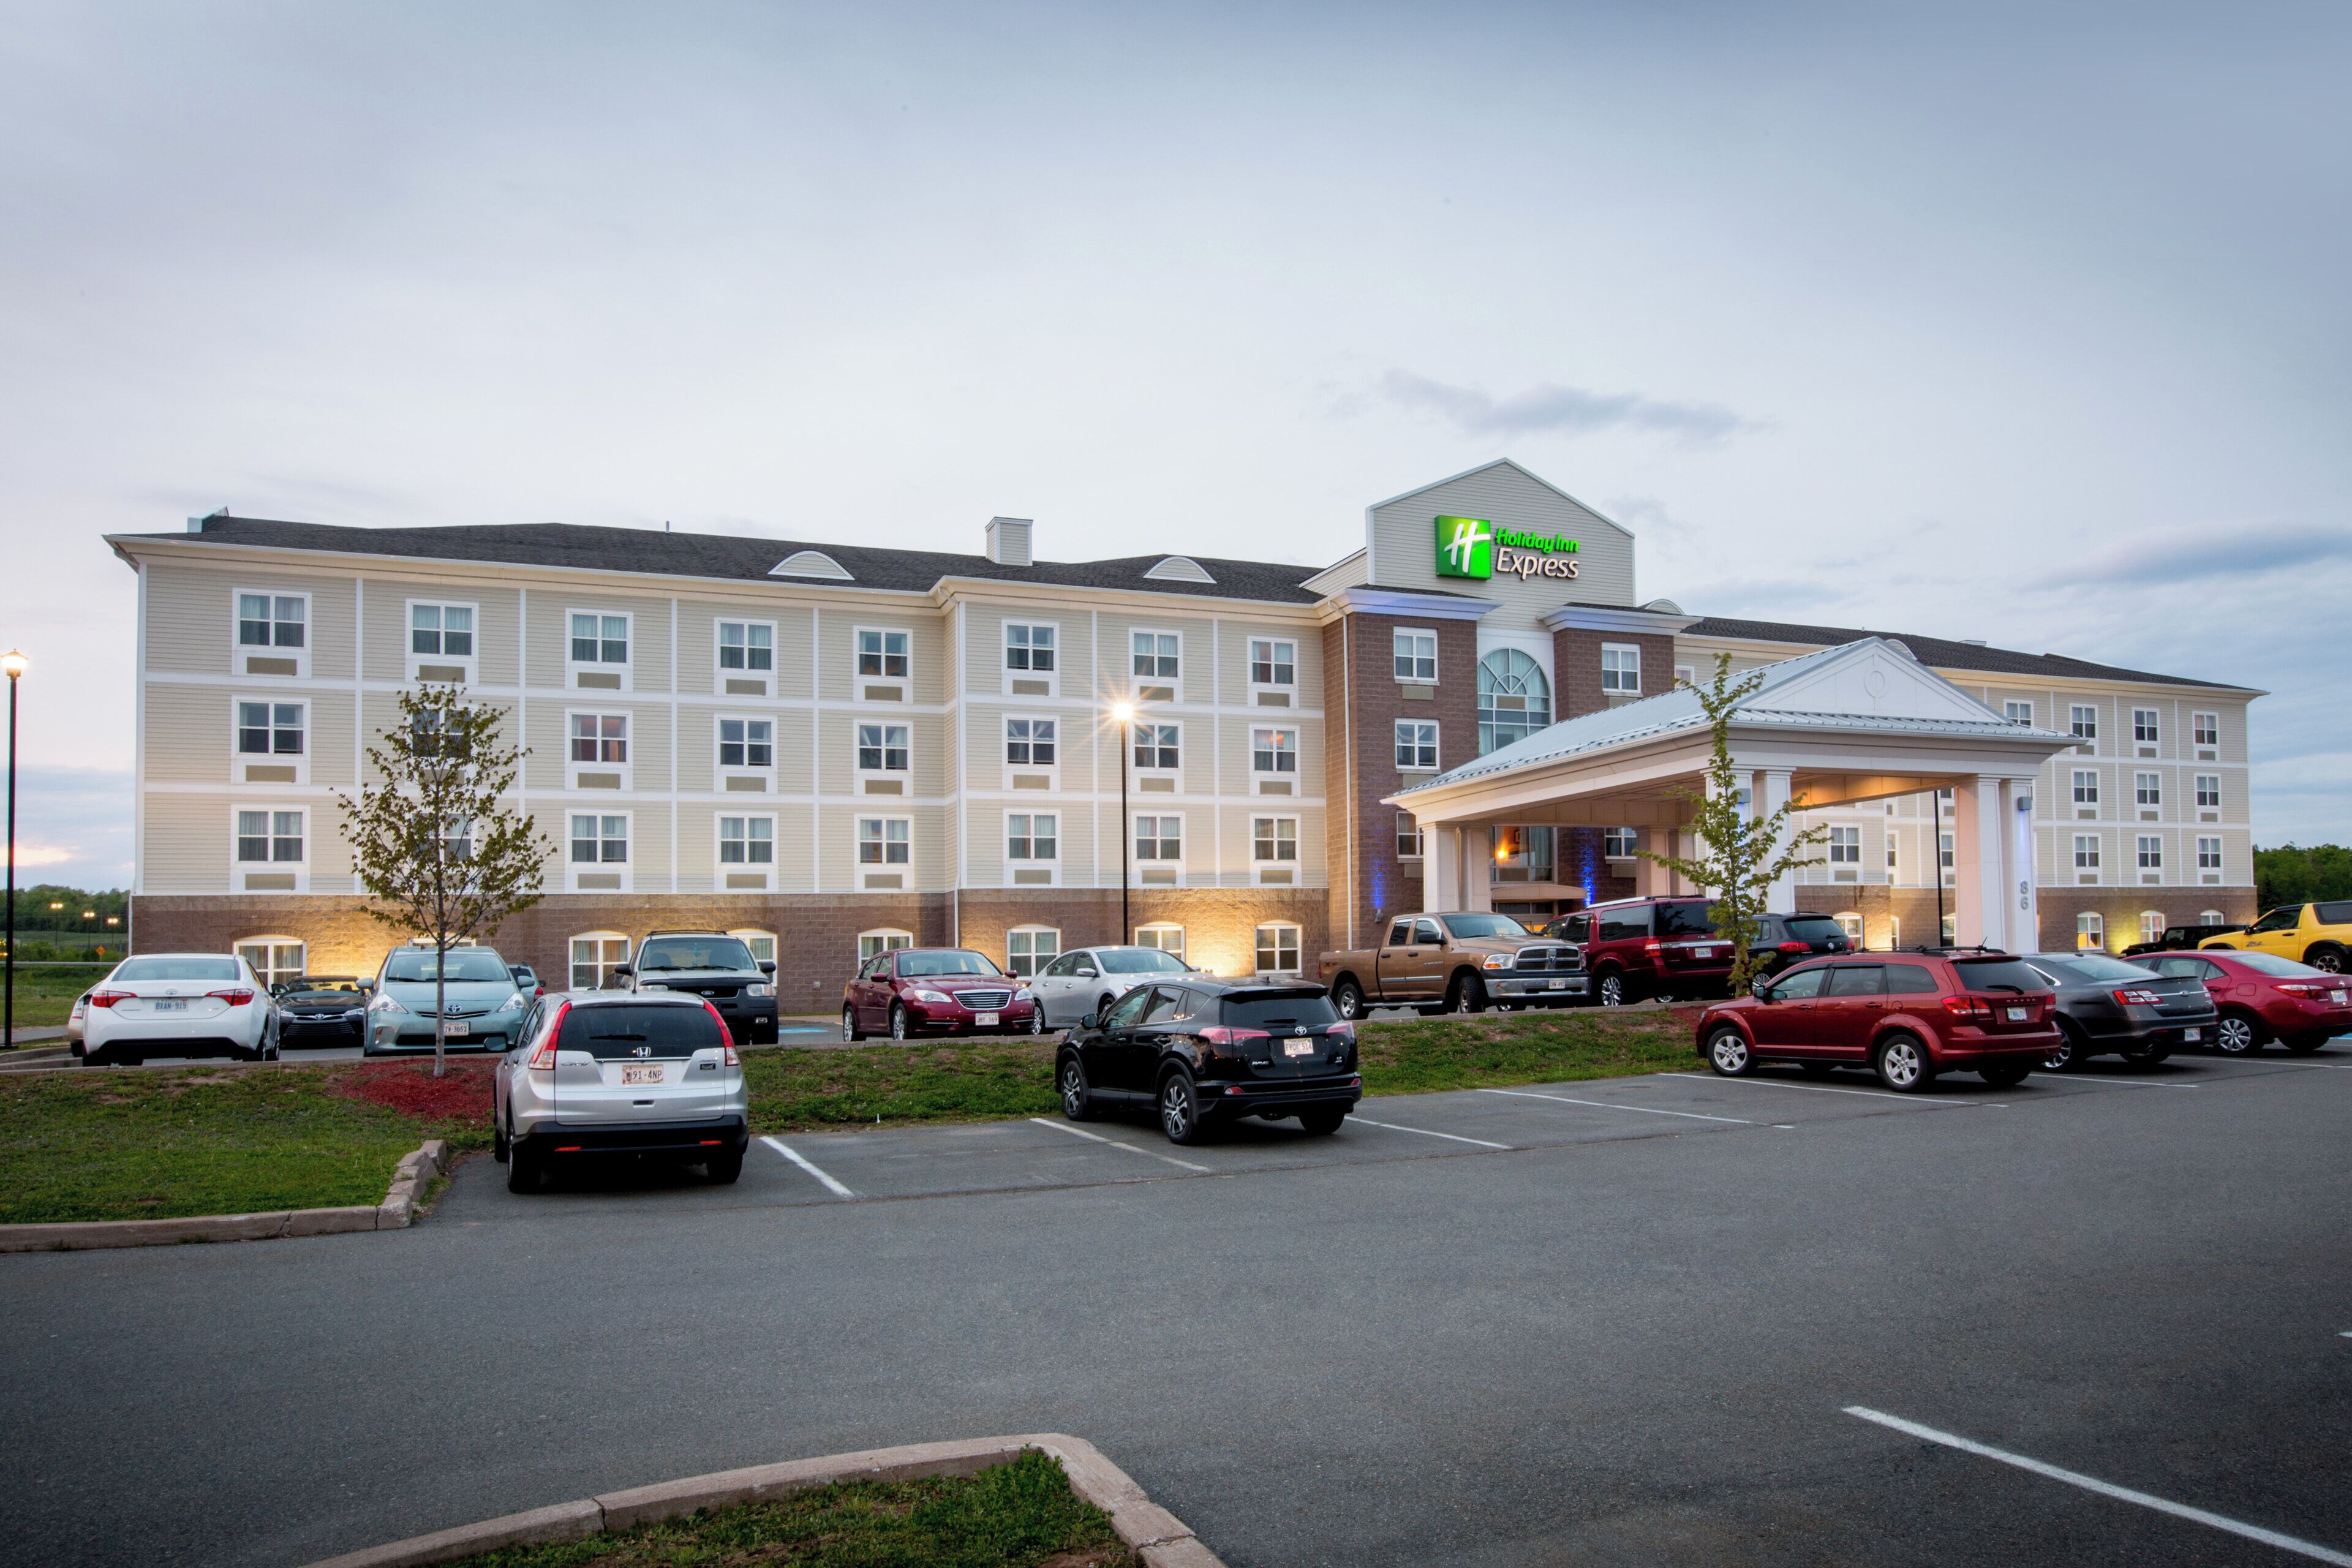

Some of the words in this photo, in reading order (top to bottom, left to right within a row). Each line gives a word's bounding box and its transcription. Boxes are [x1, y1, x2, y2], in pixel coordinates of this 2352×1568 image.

[1495, 527, 1554, 554] Holiday
[1556, 533, 1580, 552] Inn
[1496, 547, 1580, 581] Express
